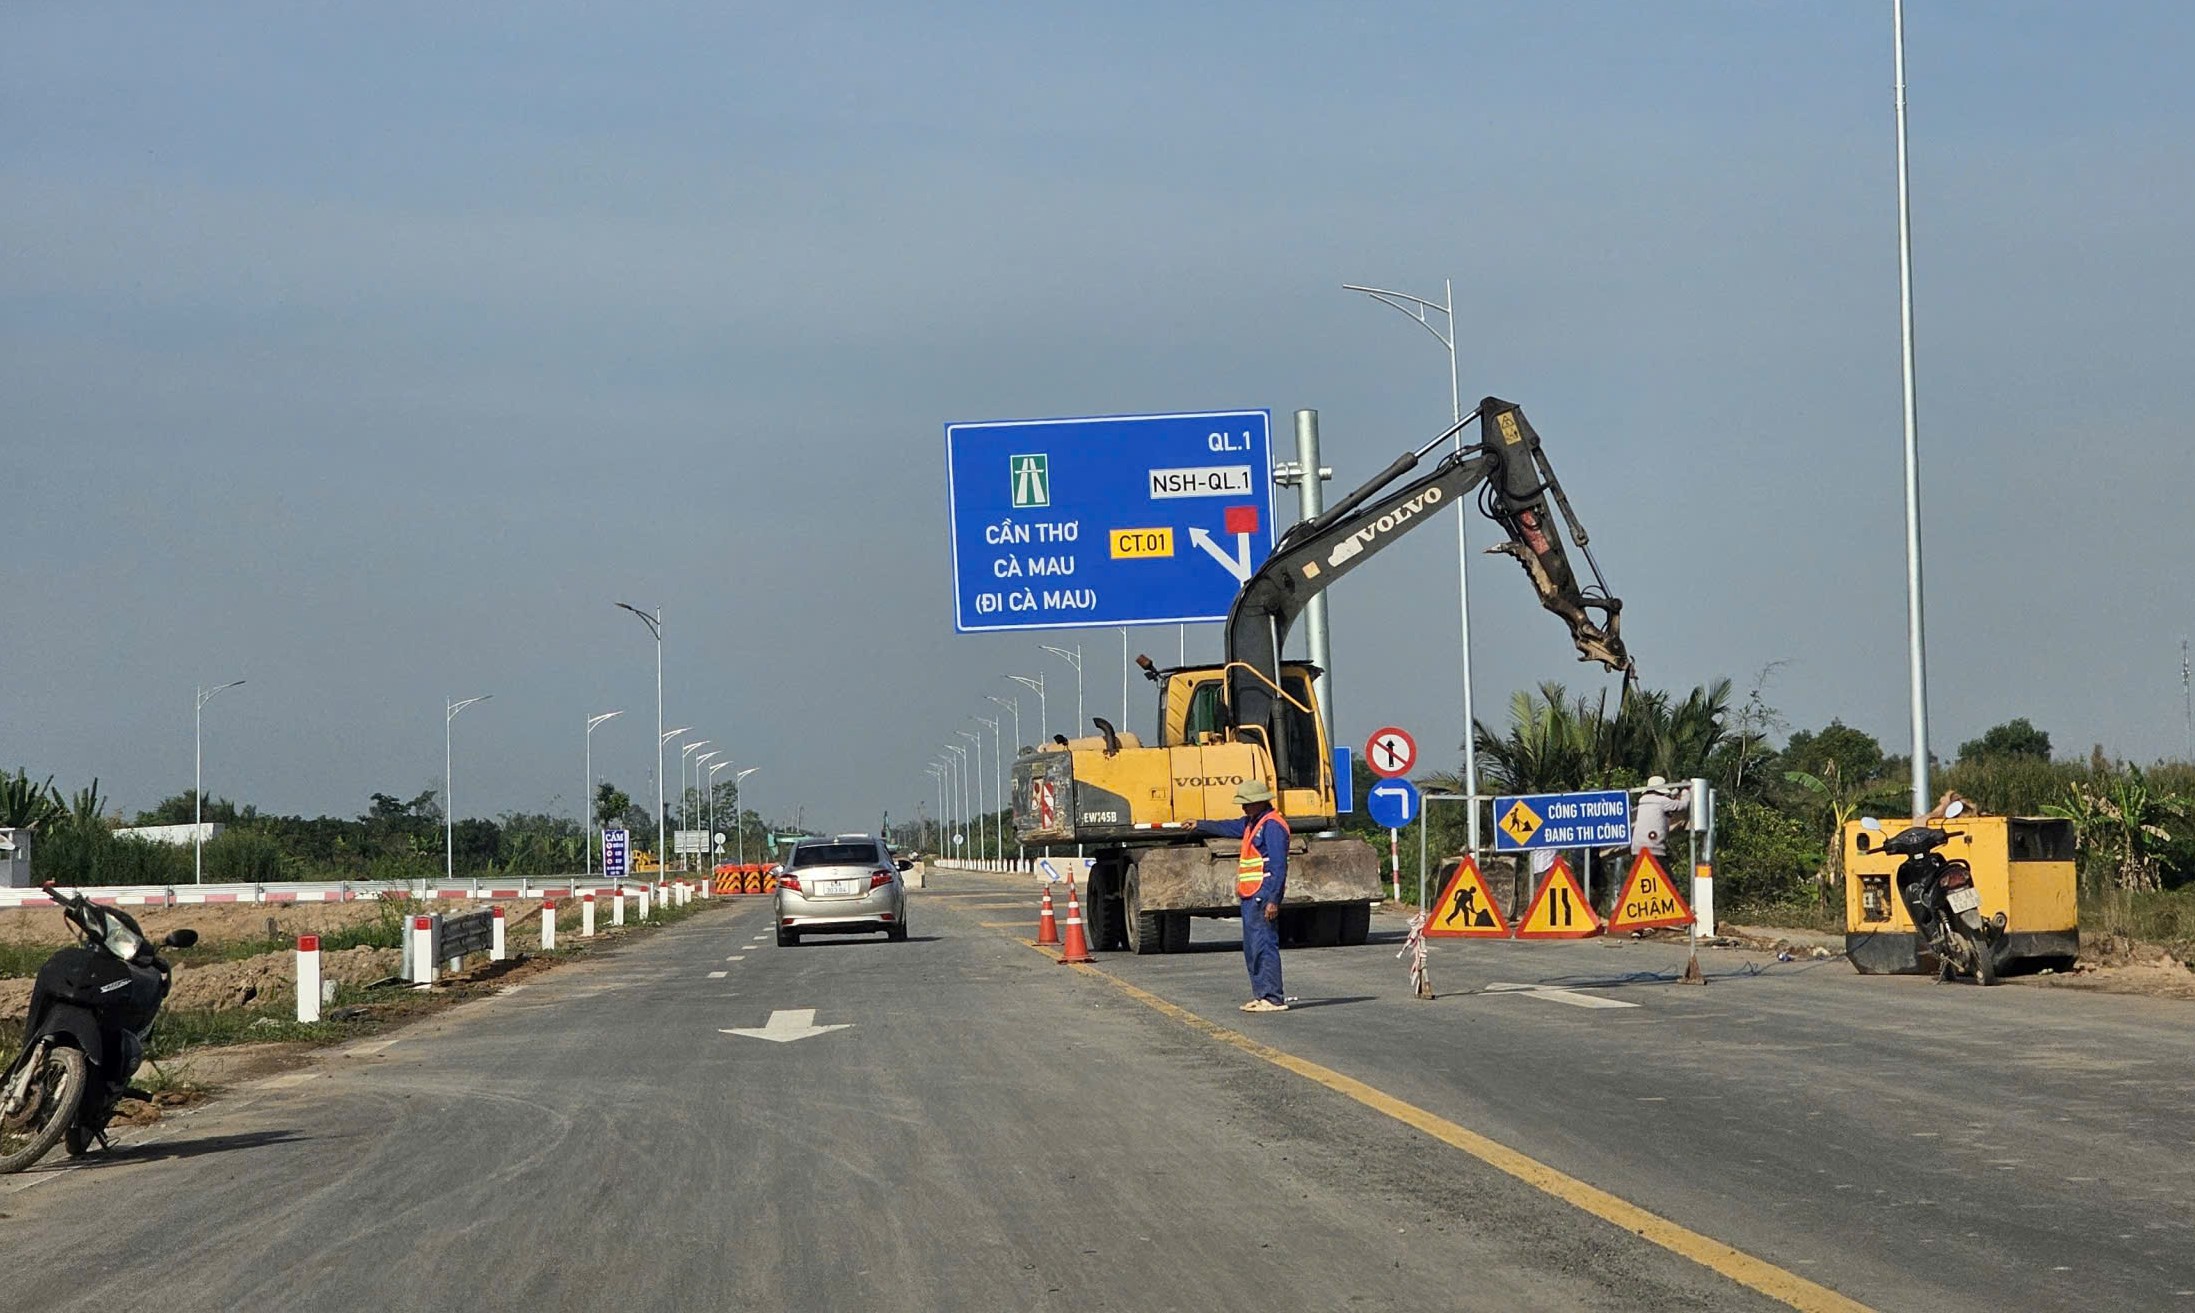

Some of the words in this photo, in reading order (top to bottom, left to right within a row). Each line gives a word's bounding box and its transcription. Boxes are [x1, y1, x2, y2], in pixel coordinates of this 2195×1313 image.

[1208, 431, 1251, 452] QL.1
[1153, 472, 1249, 493] NSH-QL.1
[1356, 487, 1442, 542] VOLVO
[985, 518, 1030, 544] CẦN
[1035, 520, 1079, 542] THƠ
[1119, 534, 1165, 552] CT.01
[993, 554, 1023, 578] CÀ
[1028, 556, 1075, 577] MAU
[975, 593, 1003, 615] (ĐI
[1009, 587, 1038, 611] CÀ
[1043, 589, 1097, 610] MAU)
[1174, 775, 1243, 787] VOLVO
[1548, 802, 1578, 820] CÔNG
[1580, 798, 1624, 818] TRƯỜNG
[1544, 827, 1574, 843] ĐANG
[1576, 826, 1594, 841] THI
[1597, 822, 1626, 840] CÔNG
[1640, 877, 1657, 894] ĐI
[1626, 896, 1675, 919] CHẬM
